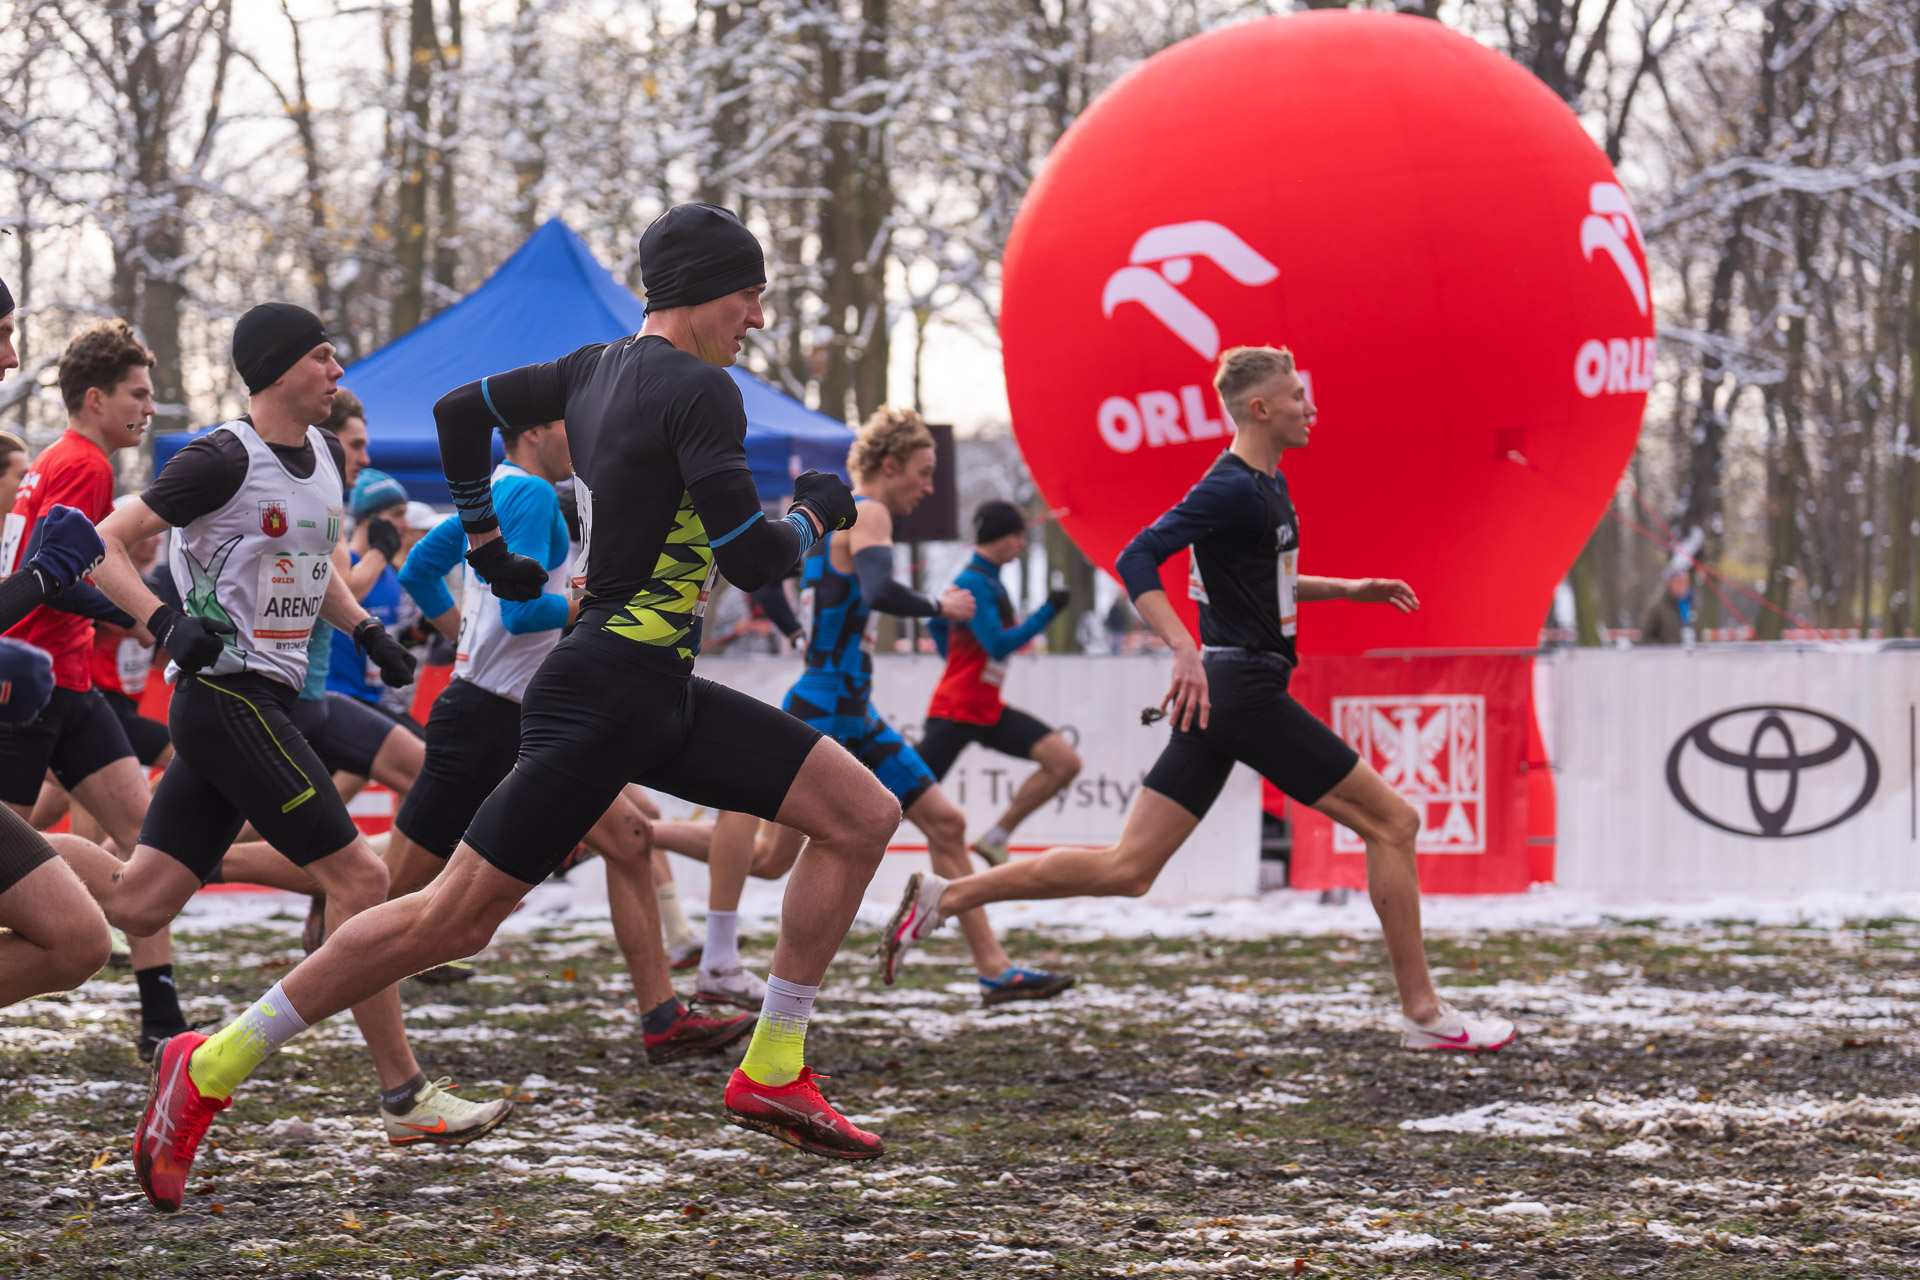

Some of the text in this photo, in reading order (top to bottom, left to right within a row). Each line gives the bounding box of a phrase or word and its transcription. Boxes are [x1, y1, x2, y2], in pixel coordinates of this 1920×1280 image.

[1097, 372, 1317, 453] ORL
[312, 561, 328, 580] 69
[959, 769, 966, 804] i
